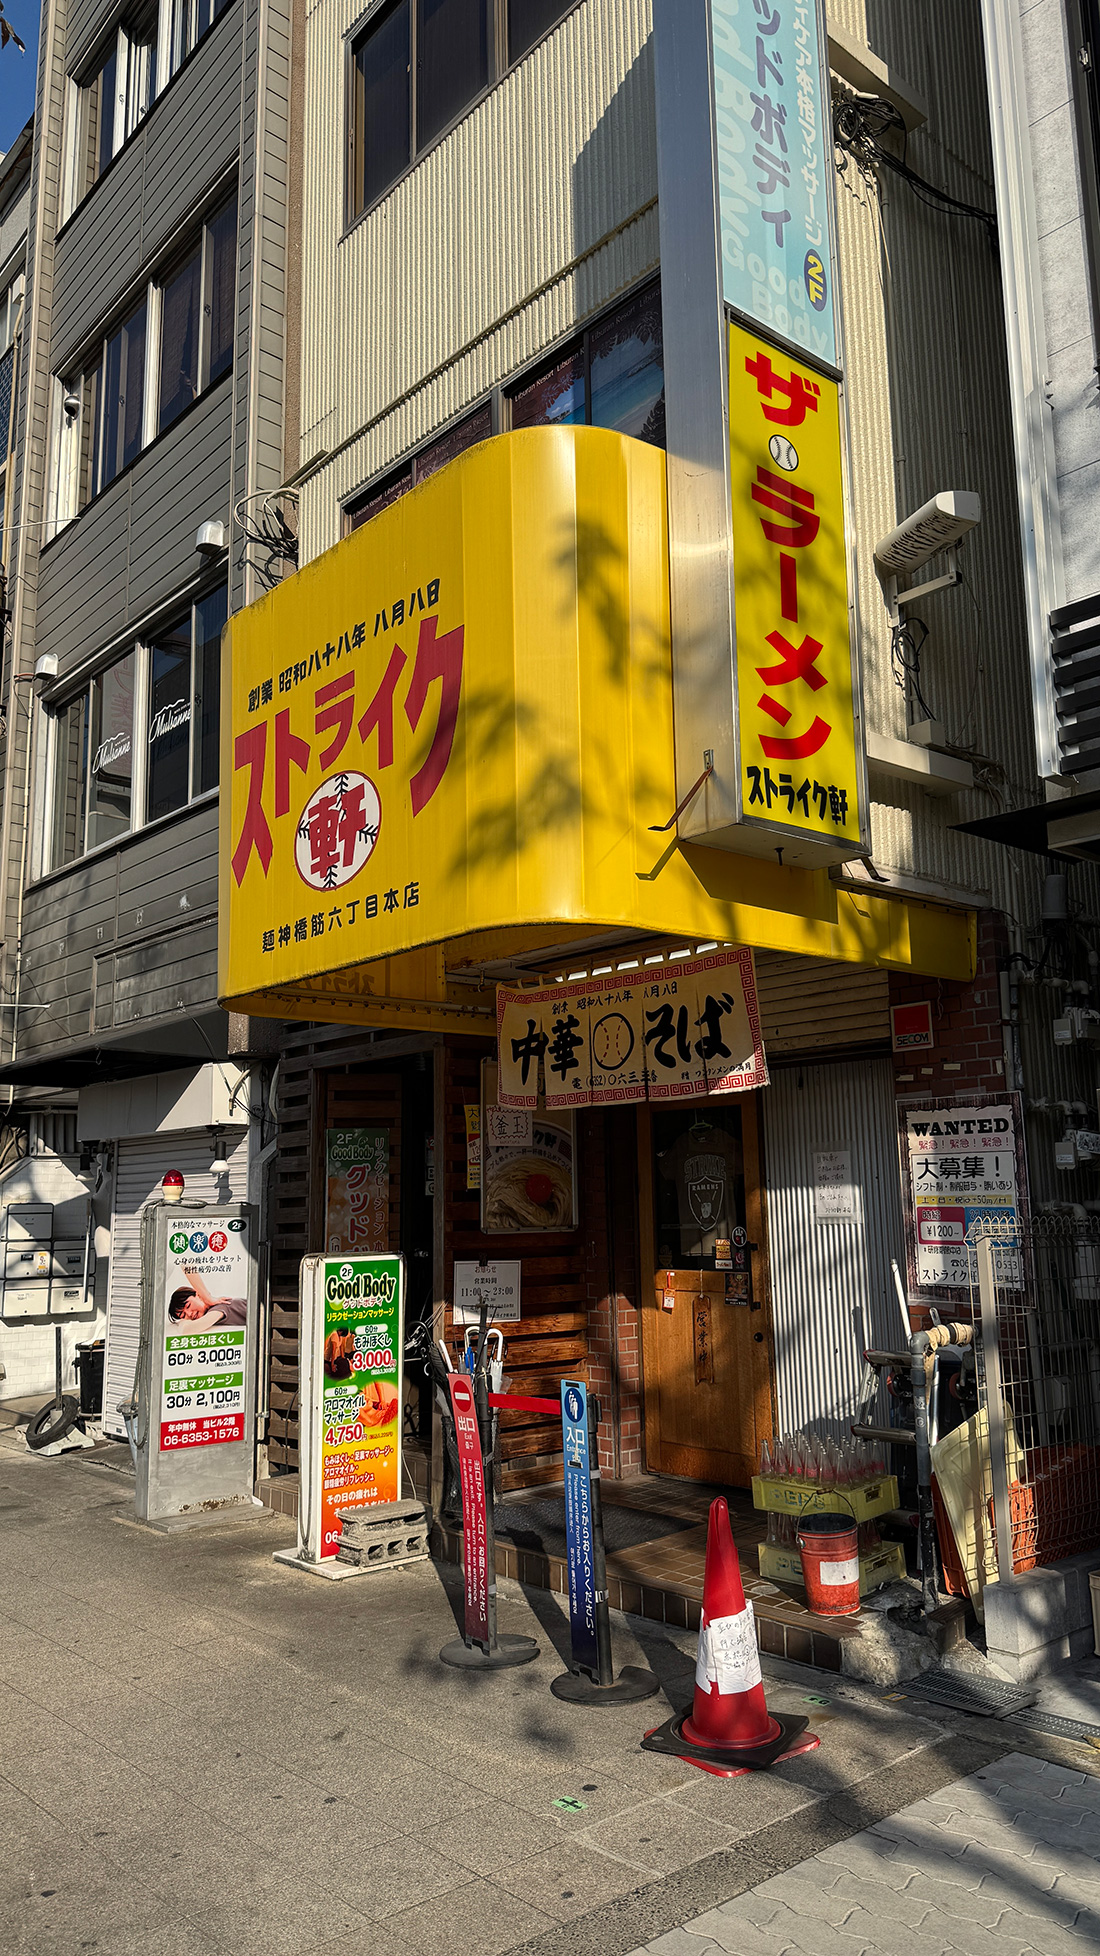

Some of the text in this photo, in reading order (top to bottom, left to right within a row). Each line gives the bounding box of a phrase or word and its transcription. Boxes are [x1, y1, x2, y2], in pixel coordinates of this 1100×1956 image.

[792, 0, 823, 246] ィケア本格マッサージ
[721, 229, 806, 311] Good
[807, 255, 825, 303] 2F
[751, 279, 829, 355] Body
[513, 382, 536, 403] Liburan
[536, 370, 555, 387] Resort
[745, 351, 832, 760] ザ ラーメン
[248, 578, 442, 713] 創業 昭和八十八年 八月八日
[231, 615, 465, 888] ストライク
[746, 766, 850, 826] ストライク軒
[308, 782, 367, 879] 軒
[552, 981, 678, 1015] 創業 昭和八十八年 八月八日
[510, 992, 735, 1087] 中華 そば
[896, 1032, 929, 1046] SECOM
[494, 1114, 524, 1136] 釜玉
[911, 1117, 1010, 1137] WANTED
[336, 1133, 354, 1145] 2F
[331, 1144, 375, 1161] Good Body
[683, 1153, 727, 1183] STRIKE
[916, 1156, 1001, 1180] 大募集！
[691, 1183, 719, 1191] RAMENS
[172, 1219, 243, 1230] 本格的なマッサージ 2F
[341, 1268, 352, 1277] 2F
[327, 1273, 396, 1303] Good Body
[326, 1307, 395, 1322] リラクゼーションマッサージ
[169, 1333, 235, 1350] 全身もみほぐし
[354, 1333, 392, 1350] もみほぐし
[168, 1348, 242, 1367] 60分 3,000円
[168, 1374, 234, 1392] 足裏マッサージ
[166, 1389, 241, 1409] 30分 2,100円
[324, 1394, 366, 1412] アロマオイル
[168, 1421, 197, 1433] 年中無休
[323, 1408, 360, 1426] マッサージ
[457, 1415, 476, 1433] 出口
[163, 1426, 240, 1446] 06-6353-1576
[566, 1426, 585, 1446] 入口
